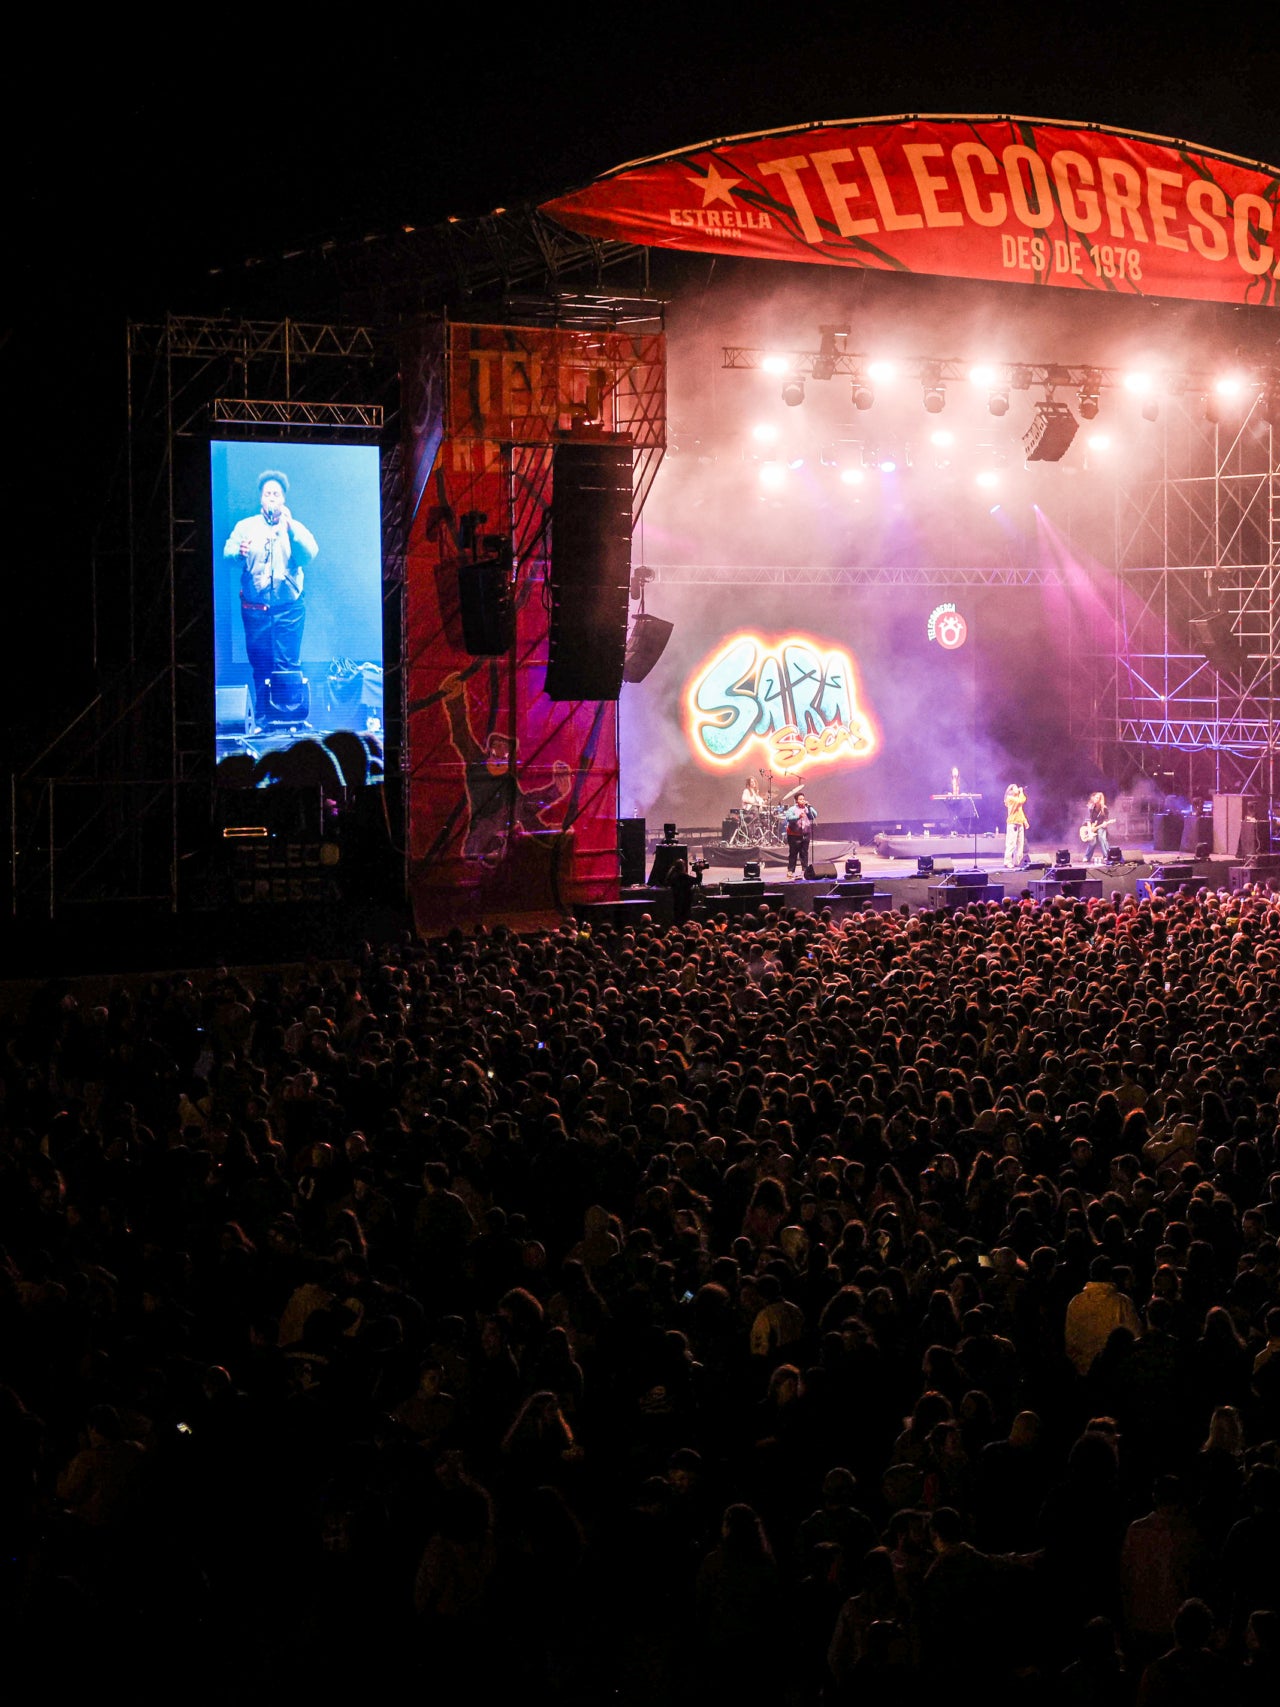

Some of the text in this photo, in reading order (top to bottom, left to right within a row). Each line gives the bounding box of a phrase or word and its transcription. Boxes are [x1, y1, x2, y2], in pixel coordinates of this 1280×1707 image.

[669, 208, 773, 230] ESTRELLA
[1001, 233, 1142, 281] DES DE 1978
